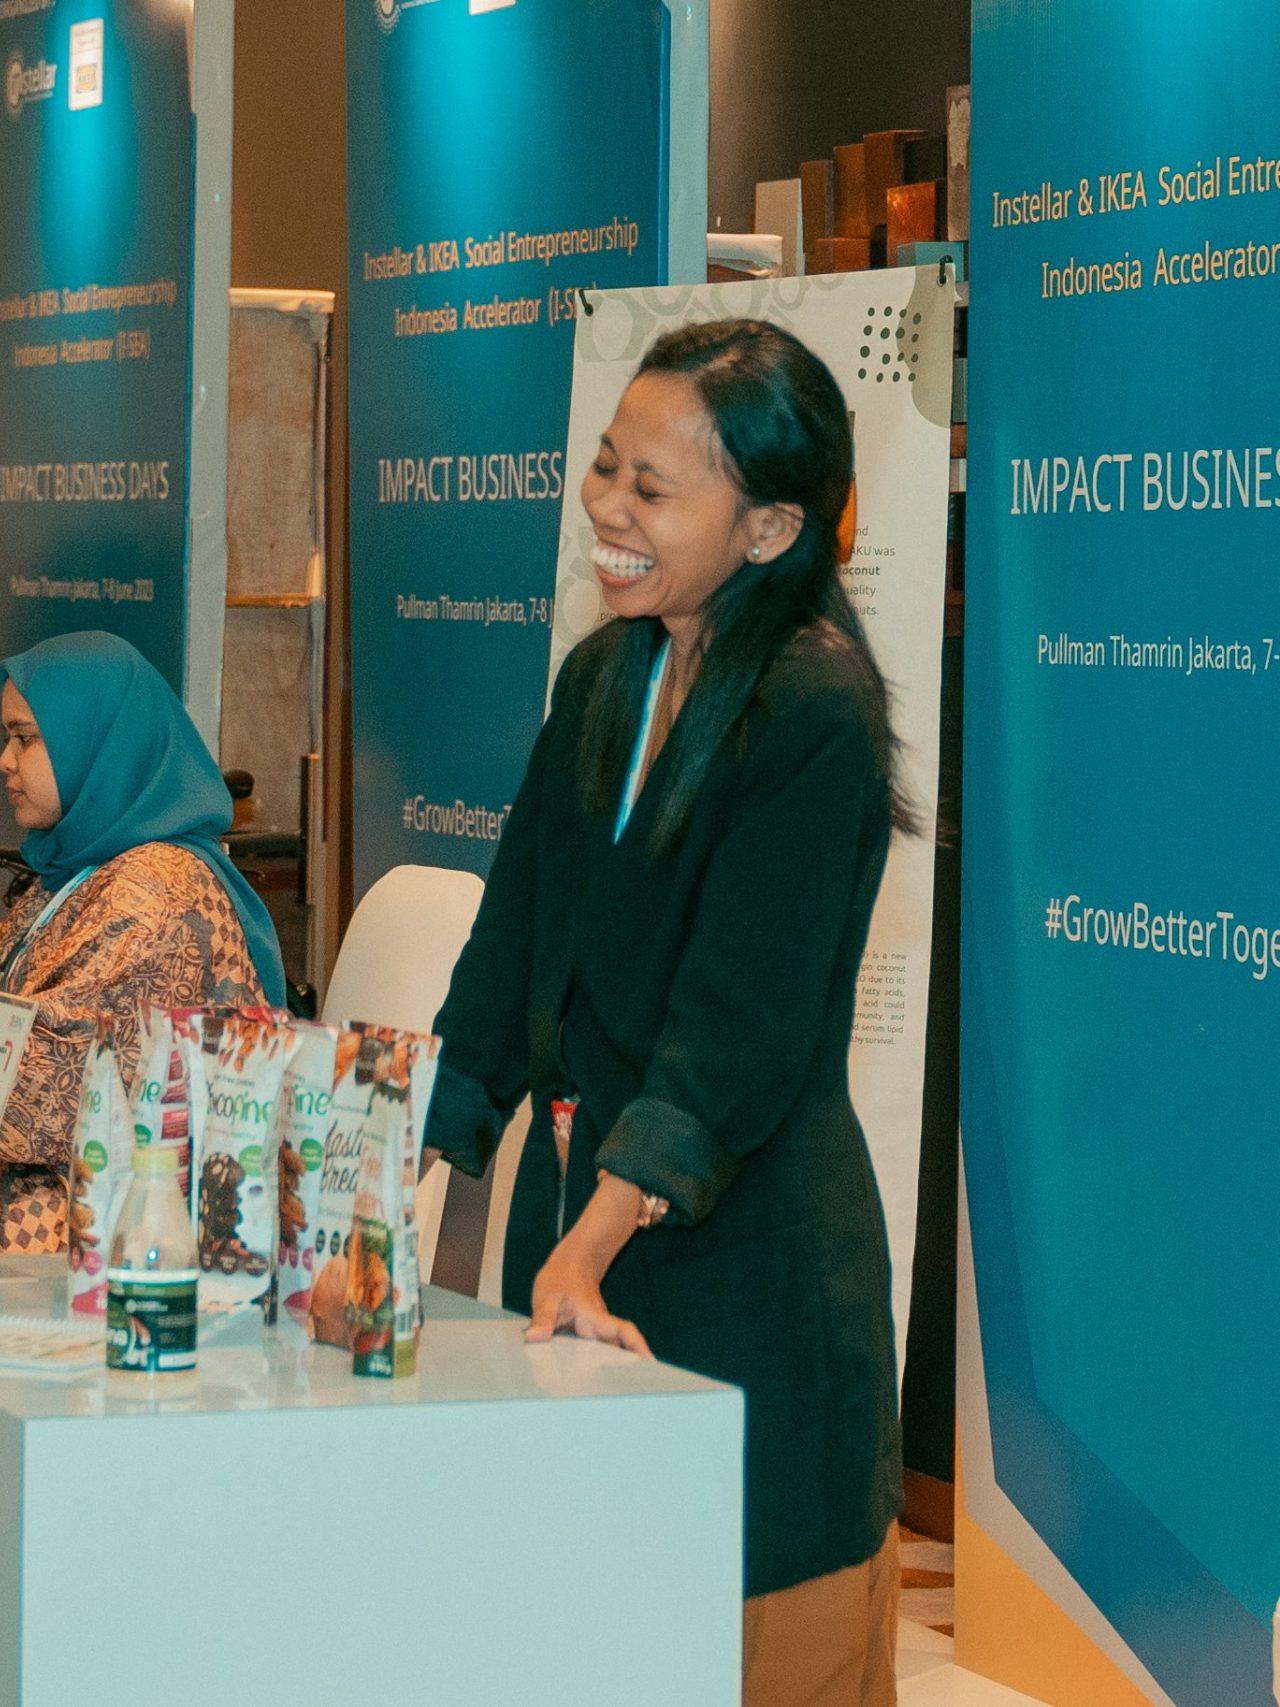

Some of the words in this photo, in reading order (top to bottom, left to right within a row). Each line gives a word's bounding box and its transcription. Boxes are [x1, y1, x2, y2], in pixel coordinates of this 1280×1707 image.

[992, 182, 1072, 228] Instellar
[1077, 178, 1094, 217] &
[1099, 170, 1147, 214] IKEA
[1158, 156, 1221, 206] Social
[364, 247, 413, 281] Instellar
[416, 243, 426, 274] &
[429, 240, 460, 273] IKEA
[465, 231, 505, 269] Social
[508, 216, 638, 266] Entrepreneurship
[1041, 252, 1142, 299] Indonesia
[1154, 240, 1280, 286] Accelerator
[395, 302, 458, 336] Indonesia
[463, 295, 542, 330] Accelerator
[55, 462, 125, 501] BUSINESS
[128, 461, 169, 500] DAYS
[379, 456, 453, 503] IMPACT
[458, 451, 562, 501] BUSINESS
[1011, 454, 1132, 515] IMPACT
[1144, 447, 1280, 511] BUSINE
[875, 547, 895, 556] was
[397, 595, 438, 620] Pullman
[440, 595, 484, 621] Thamrin
[485, 596, 526, 626] Jakarta,
[529, 598, 547, 622] 7-8
[847, 584, 876, 597] uality
[1038, 633, 1105, 665] Pullman
[1110, 634, 1182, 668] Thamrin
[1186, 635, 1256, 675] Jakarta,
